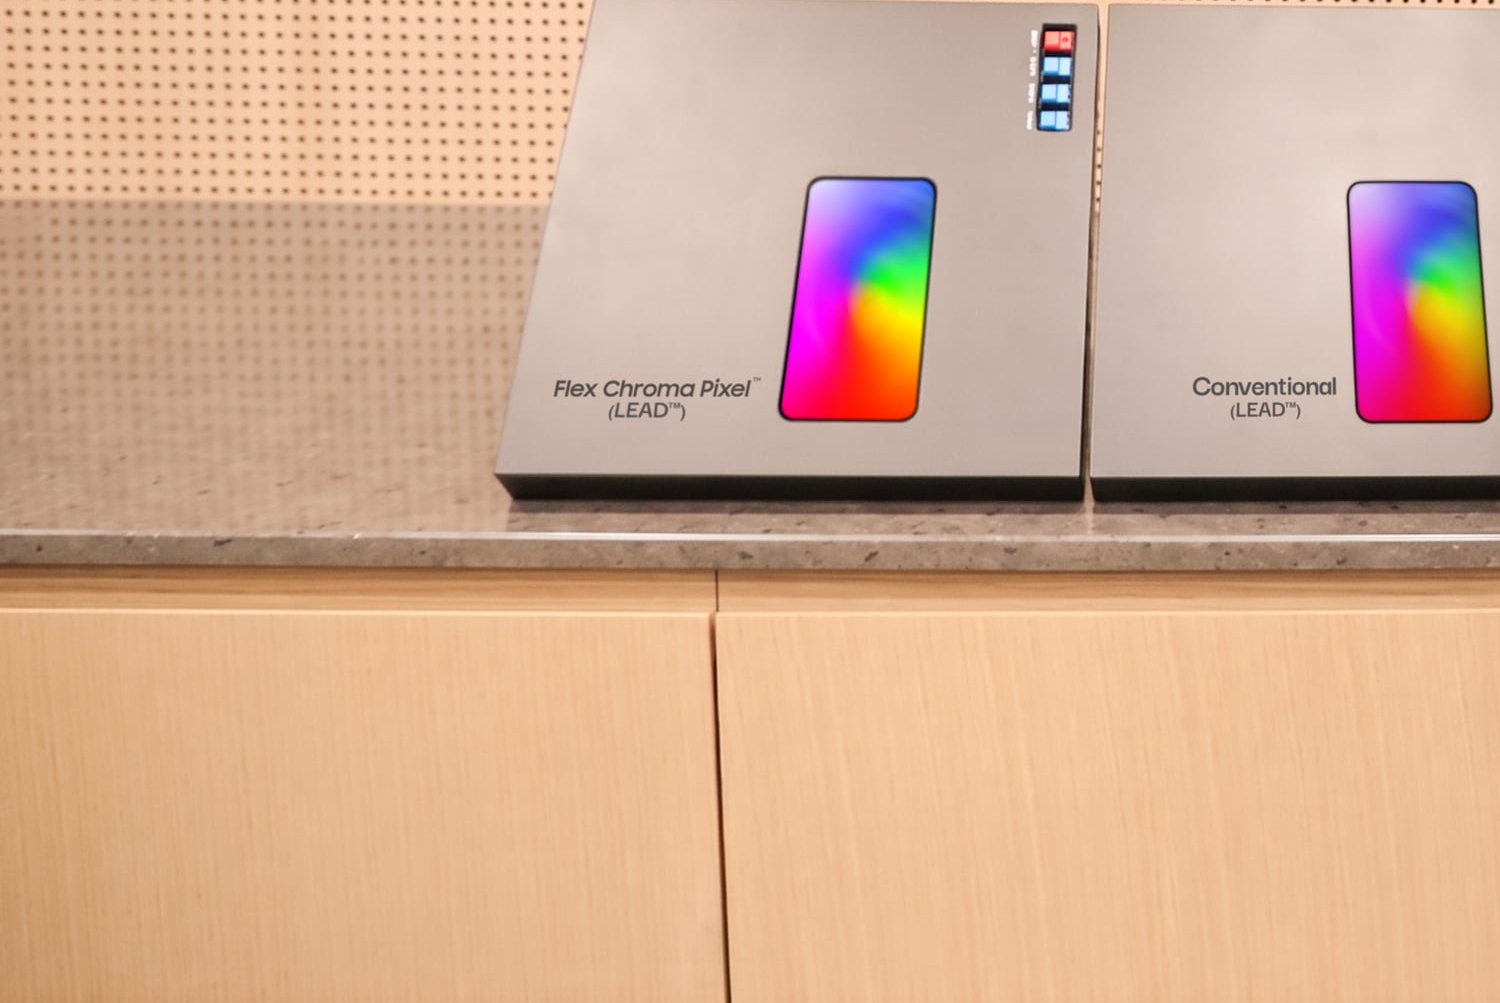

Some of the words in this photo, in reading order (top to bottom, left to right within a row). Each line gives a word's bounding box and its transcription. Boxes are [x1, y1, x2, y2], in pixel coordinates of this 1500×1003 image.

[553, 379, 598, 398] Flex
[603, 379, 695, 398] Chroma
[1192, 376, 1337, 397] Conventional
